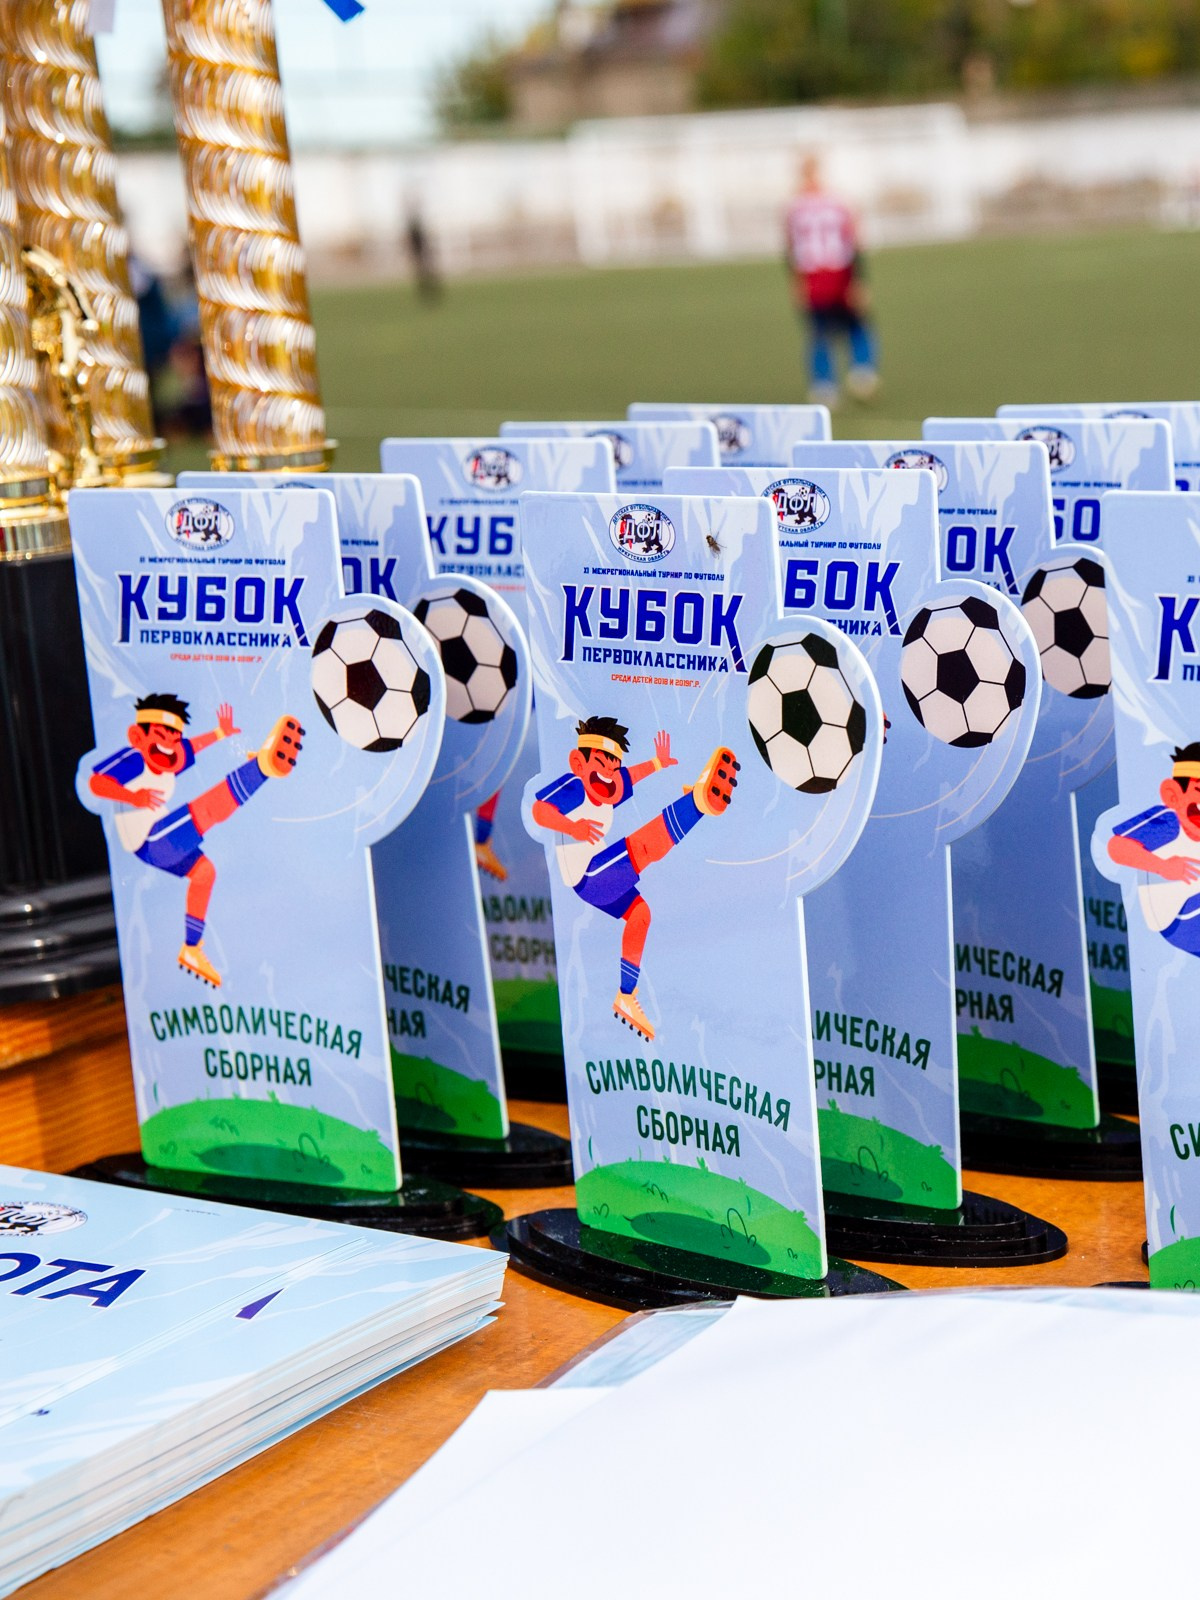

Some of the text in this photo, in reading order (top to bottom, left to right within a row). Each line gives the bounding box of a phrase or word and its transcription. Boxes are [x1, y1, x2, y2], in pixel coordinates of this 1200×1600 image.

[180, 511, 222, 534] ДФЛ
[777, 492, 818, 517] ДФЛ
[427, 516, 514, 556] КУБ
[623, 518, 663, 544] ДФЛ
[684, 572, 693, 580] ПО
[694, 573, 725, 582] ФУТБОЛУ
[117, 573, 311, 648] КУБОК
[784, 559, 903, 636] БОК
[140, 629, 292, 648] ПЕРВОКЛАССНИКА
[560, 584, 749, 674] КУБОК
[583, 646, 729, 673] ПЕРВОКЛАССНИКА
[611, 673, 632, 684] СРЕДИ
[490, 933, 557, 967] СБОРН
[955, 943, 1064, 999] ИЧЕСКАЯ
[955, 988, 1014, 1024] РНАЯ
[149, 1003, 363, 1059] СИМВОЛИЧЕСКАЯ
[812, 1009, 931, 1071] ИЧЕСКАЯ
[203, 1047, 313, 1087] СБОРНАЯ
[813, 1058, 875, 1098] РНАЯ
[585, 1057, 791, 1132] СИМВОЛИЧЕСКАЯ
[636, 1104, 741, 1158] СБОРНАЯ
[0, 1252, 147, 1308] ОТА
